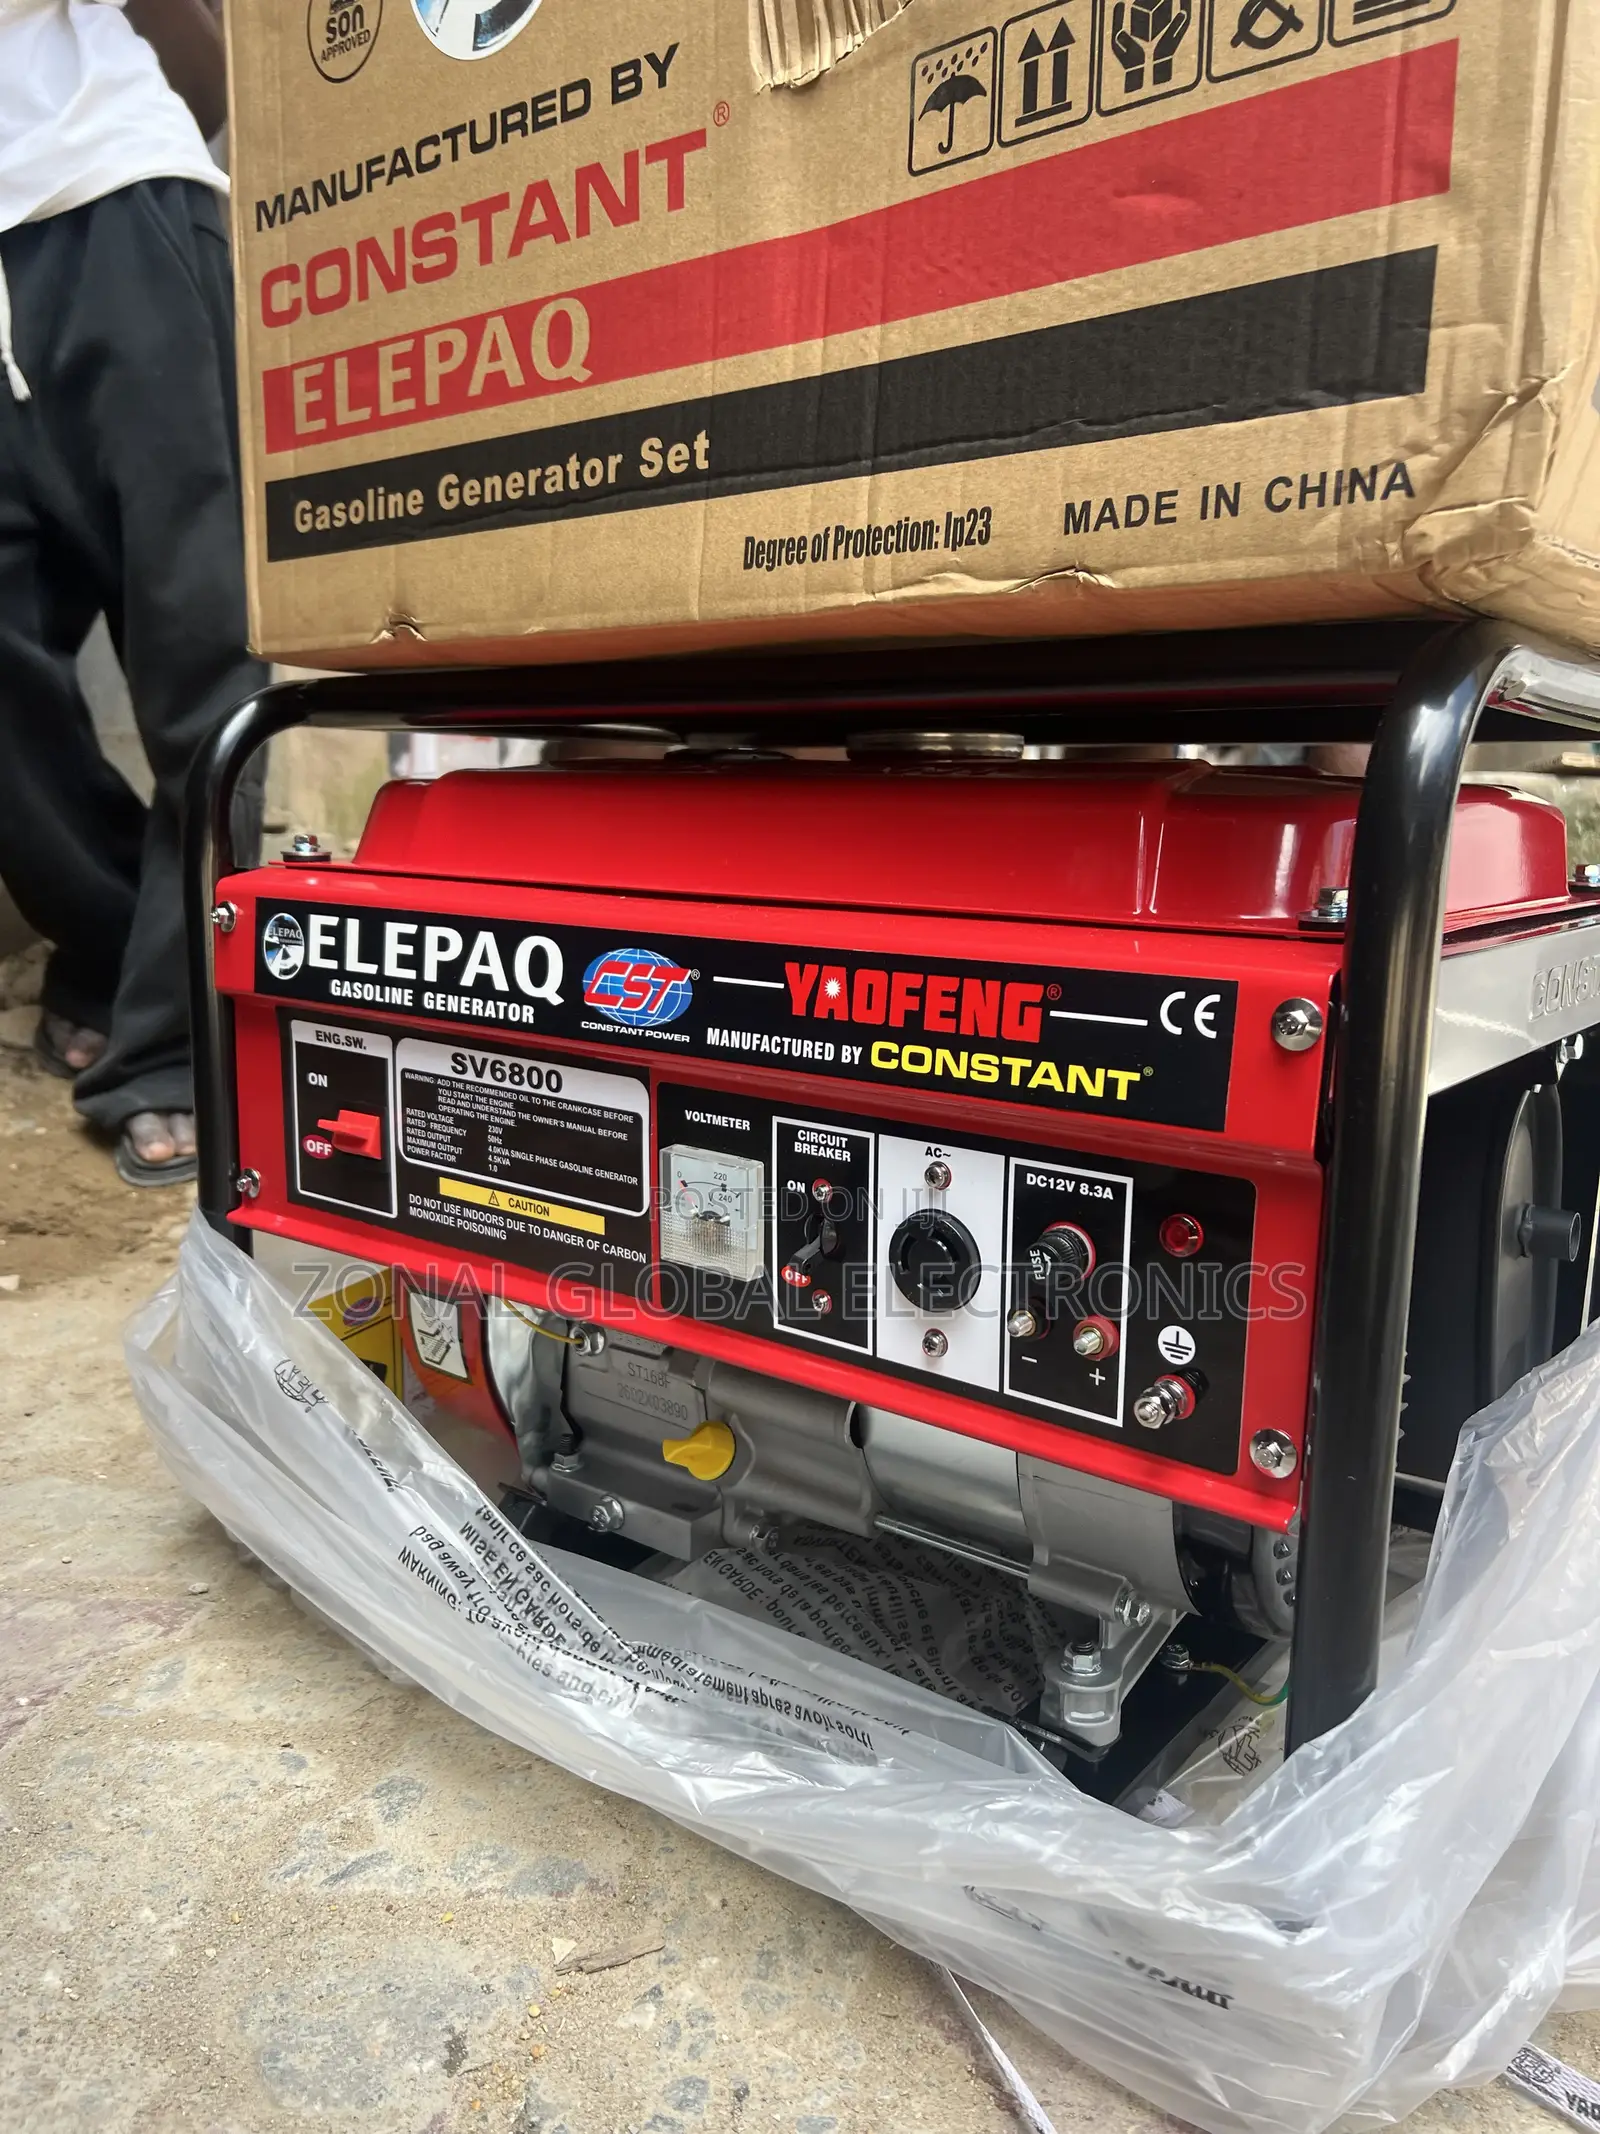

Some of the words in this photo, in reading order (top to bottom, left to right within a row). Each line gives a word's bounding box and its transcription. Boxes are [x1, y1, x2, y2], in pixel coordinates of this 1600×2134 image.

[320, 29, 371, 63] APPROVED
[256, 78, 591, 231] MANUFACTURED
[611, 42, 680, 104] BY
[260, 129, 707, 328] CONSTANT
[292, 297, 593, 436] ELEPAQ
[294, 487, 424, 534] Gasoline
[438, 452, 623, 510] Generator
[639, 430, 710, 479] Set
[1063, 489, 1179, 535] MADE
[1200, 481, 1241, 520] IN
[1264, 462, 1416, 513] CHINA
[743, 531, 808, 571] Degree
[811, 526, 830, 561] of
[834, 515, 939, 559] Protection:
[307, 913, 564, 1005] ELEPAQ
[331, 979, 414, 1007] GASOLINE
[423, 992, 535, 1024] GENERATOR
[784, 962, 1045, 1043] YAOFENG
[315, 1030, 367, 1050] ENG.SW.
[450, 1052, 563, 1093] SV6800
[706, 1027, 836, 1062] MANUFACTURED
[841, 1045, 862, 1065] BY
[870, 1041, 1141, 1101] CONSTANT
[307, 1072, 328, 1088] ON
[437, 1079, 451, 1087] ADD
[452, 1081, 465, 1090] THE
[466, 1083, 518, 1100] RECOMMENDED
[519, 1093, 529, 1103] OIL
[531, 1096, 541, 1105] TO
[542, 1098, 556, 1108] THE
[558, 1101, 602, 1117] CRANKCASE
[603, 1110, 634, 1124] BEFORE
[438, 1088, 452, 1097] YOU
[453, 1091, 474, 1101] START
[475, 1095, 489, 1104] THE
[406, 1107, 426, 1118] RATED
[426, 1111, 454, 1125] VOLTAGE
[438, 1104, 475, 1119] OPERATING
[476, 1112, 490, 1122] THE
[438, 1096, 456, 1105] READ
[456, 1099, 471, 1108] AND
[472, 1103, 517, 1118] UNDERSTAND
[518, 1111, 531, 1121] THE
[532, 1114, 565, 1128] OWNER'S
[566, 1122, 597, 1135] MANUAL
[598, 1128, 628, 1141] BEFORE
[685, 1109, 750, 1131] VOLTMETER
[406, 1117, 426, 1128] RATED
[430, 1121, 467, 1137] FREQUENCY
[406, 1126, 426, 1137] RATED
[427, 1131, 451, 1143] OUTPUT
[488, 1125, 503, 1135] 230V
[797, 1129, 848, 1148] CIRCUIT
[306, 1140, 332, 1156] OFF
[406, 1135, 436, 1149] MAXIMUM
[437, 1142, 463, 1155] OUTPUT
[487, 1134, 503, 1145] 50Hz
[407, 1144, 430, 1157] POWER
[431, 1150, 456, 1163] FACTOR
[794, 1141, 851, 1163] BREAKER
[510, 1149, 534, 1162] SINGLE
[535, 1155, 557, 1168] PHASE
[558, 1160, 594, 1176] GASOLINE
[595, 1168, 638, 1186] GENERATOR
[714, 1172, 728, 1181] 220
[718, 1193, 733, 1203] 240
[787, 1180, 806, 1193] ON
[1026, 1173, 1076, 1194] DC12V
[1079, 1182, 1114, 1200] 8.3A
[508, 1197, 550, 1217] CAUTION
[409, 1206, 455, 1229] MONOXIDE
[457, 1217, 507, 1241] POISONING
[409, 1193, 422, 1206] DO
[423, 1196, 442, 1210] NOT
[443, 1200, 461, 1214] USE
[463, 1206, 505, 1227] INDOORS
[507, 1218, 526, 1233] DUE
[527, 1224, 541, 1237] TO
[543, 1228, 585, 1248] DANGER
[586, 1238, 601, 1252] OF
[602, 1243, 647, 1264] CARBON
[1029, 1248, 1047, 1281] FUSE
